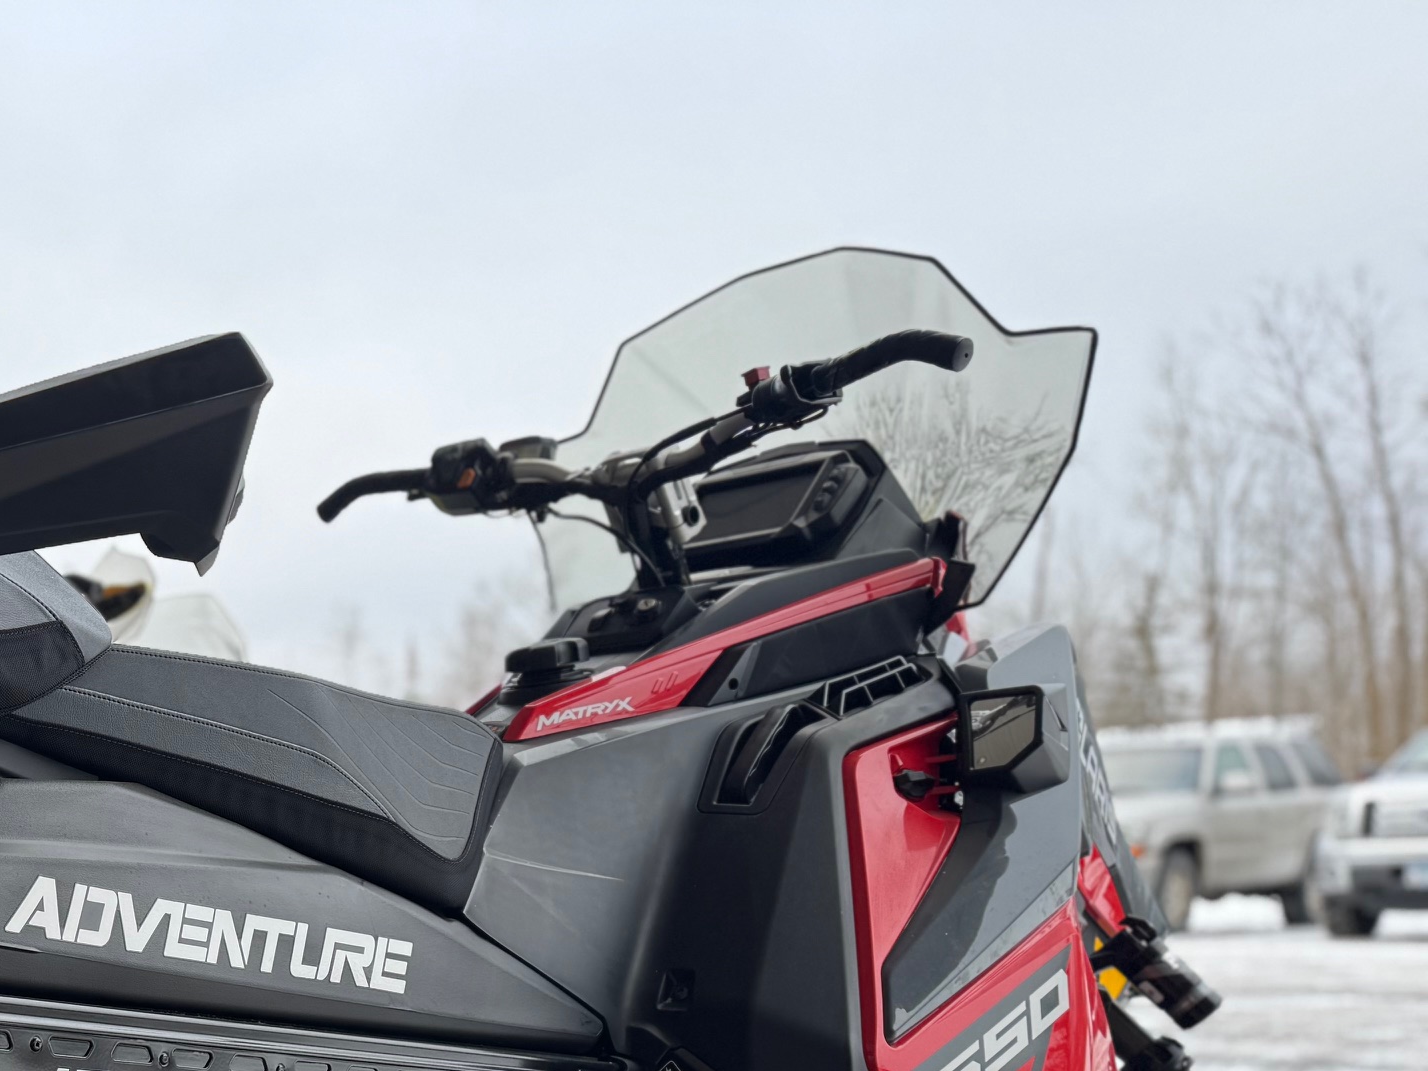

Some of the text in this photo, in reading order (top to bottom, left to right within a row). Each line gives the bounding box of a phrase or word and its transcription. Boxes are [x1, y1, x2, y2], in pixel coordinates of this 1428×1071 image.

[536, 696, 635, 731] MATRYX
[1076, 697, 1117, 845] LARIS
[5, 875, 413, 994] ADVENTURE
